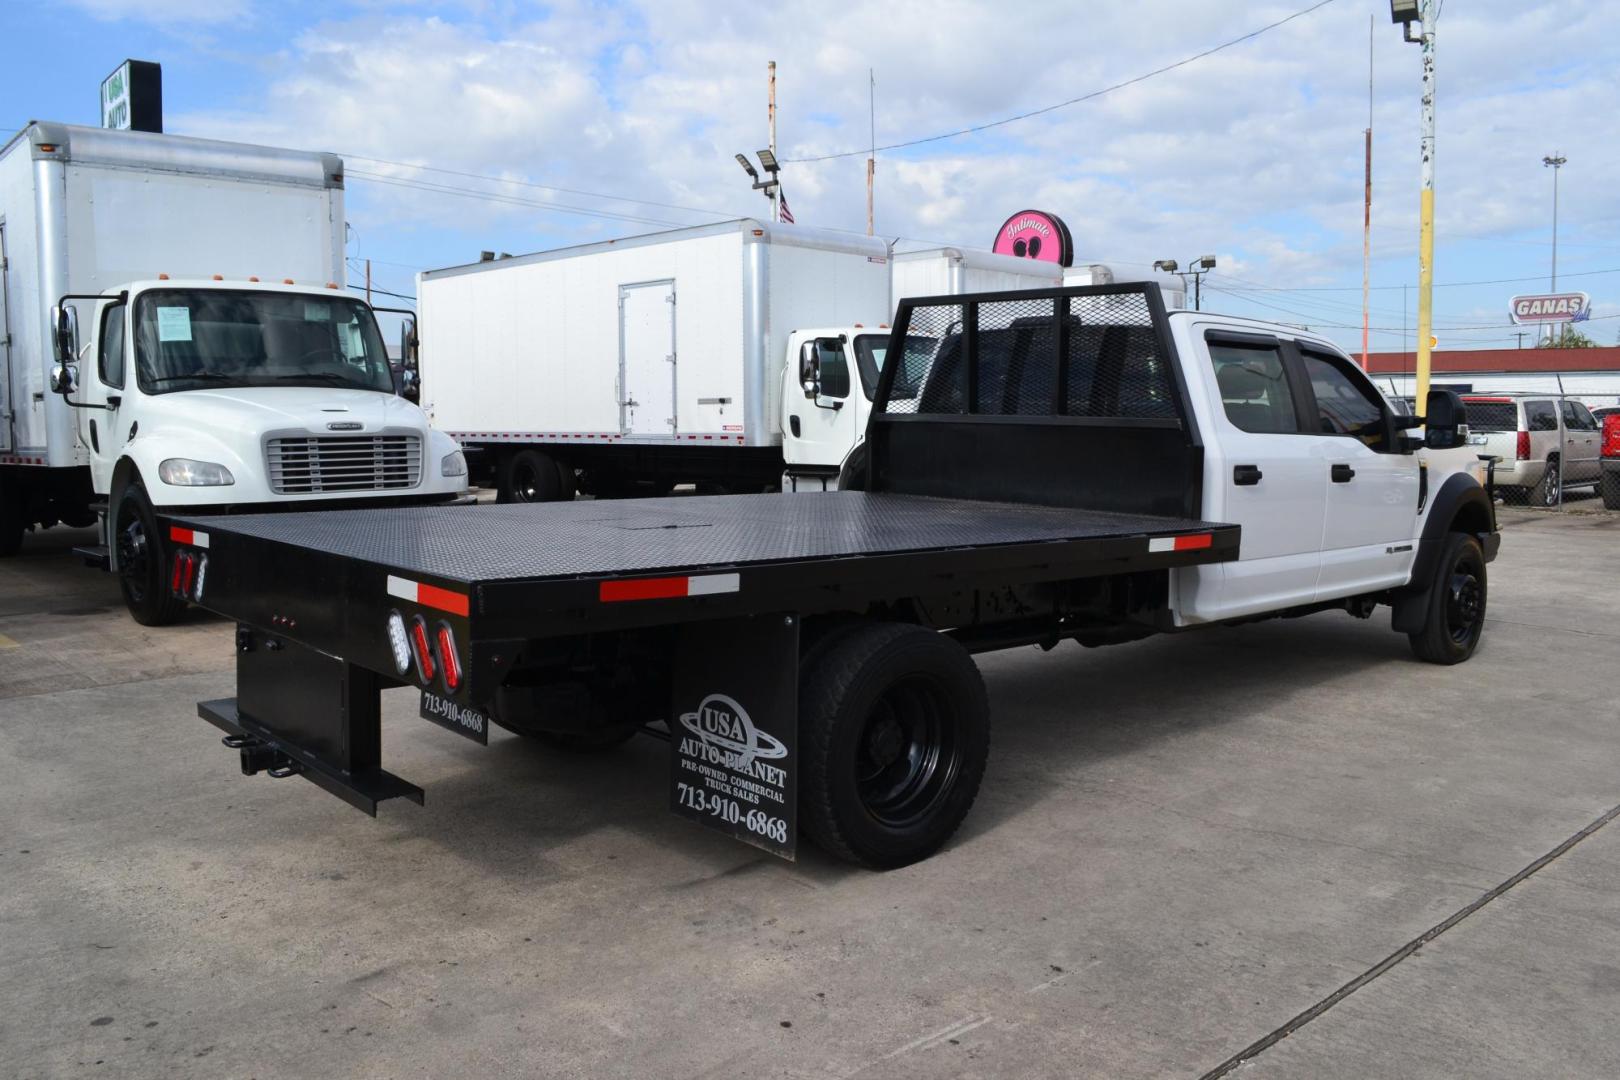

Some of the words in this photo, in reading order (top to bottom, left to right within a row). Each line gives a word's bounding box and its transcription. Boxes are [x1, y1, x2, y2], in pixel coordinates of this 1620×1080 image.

[1006, 217, 1050, 240] Intimate
[1516, 298, 1581, 316] GANAS
[424, 692, 483, 733] 713-910-6868
[703, 707, 746, 743] USA
[679, 736, 787, 788] AUTO-PLANET
[681, 758, 728, 782] PRE-OWNED
[730, 775, 785, 804] COMMERCIAL
[704, 777, 732, 795] TRUCK
[732, 786, 760, 805] SALES
[677, 782, 787, 844] 713-910-6868
